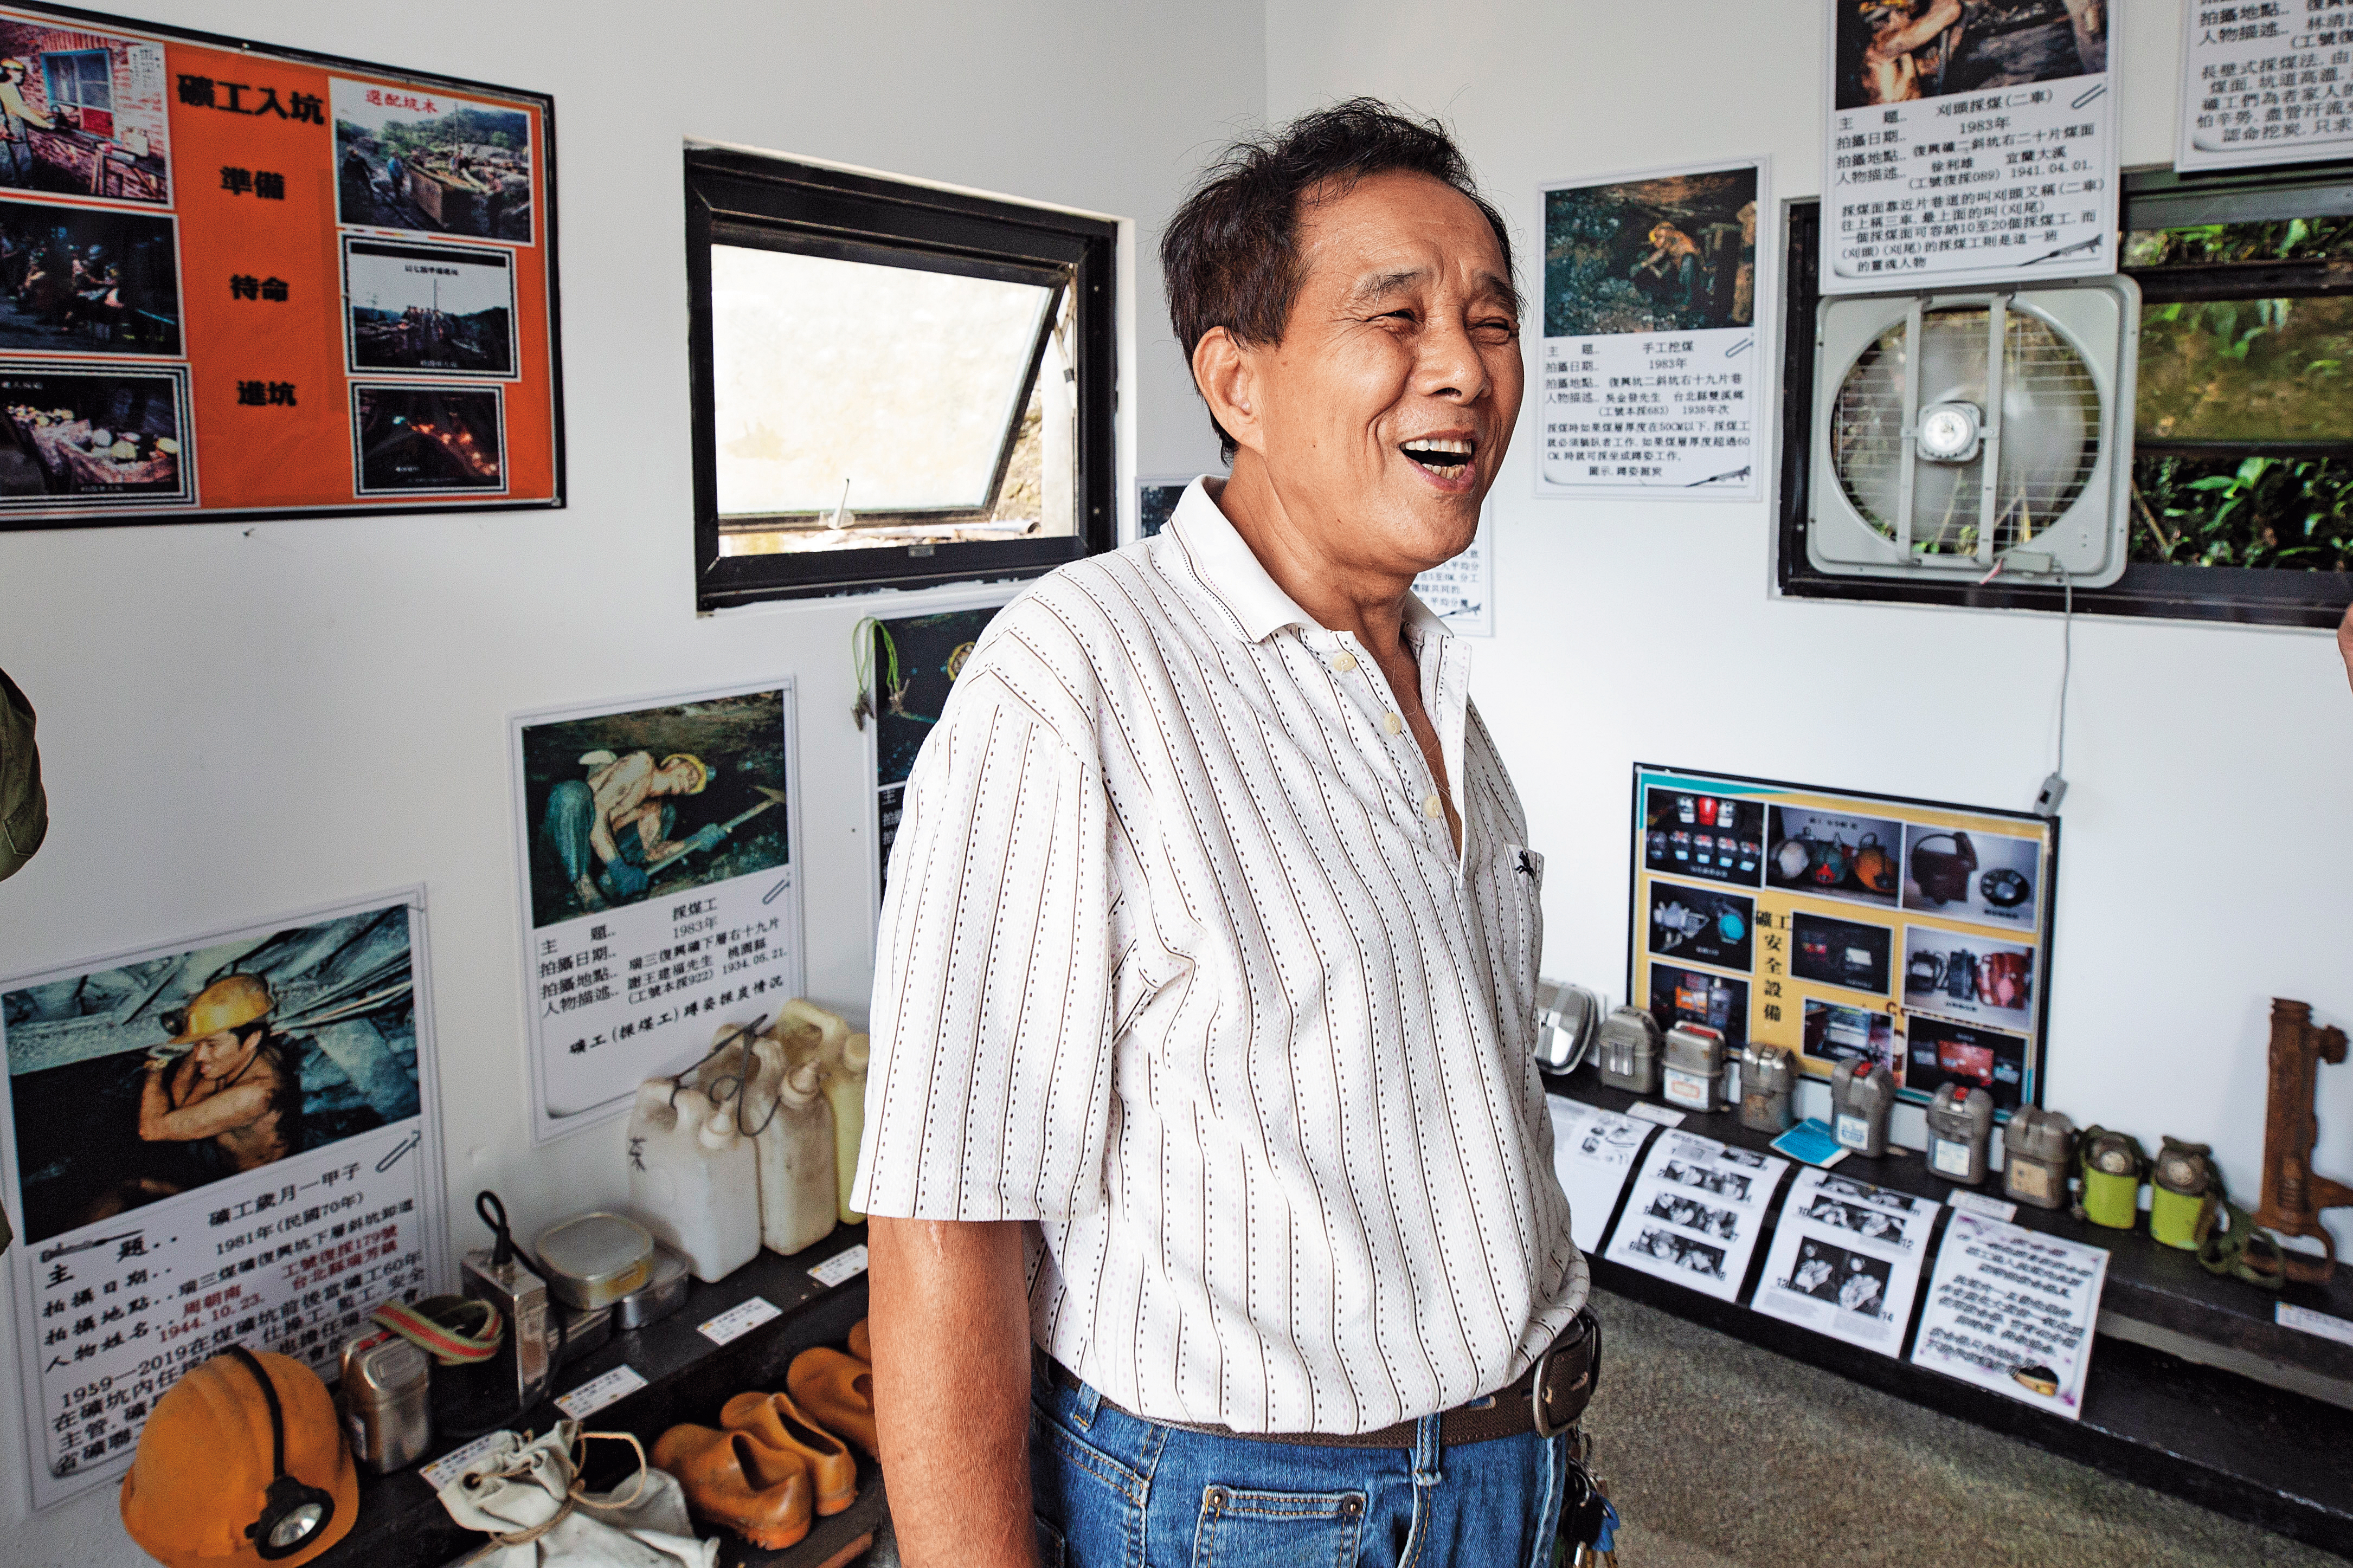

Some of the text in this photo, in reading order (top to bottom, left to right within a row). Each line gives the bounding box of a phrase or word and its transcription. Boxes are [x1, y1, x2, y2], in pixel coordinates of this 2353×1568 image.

[2307, 13, 2353, 30] 林清
[176, 74, 324, 126] 礦工入坑
[1840, 117, 1853, 131] 主
[1960, 117, 2009, 134] 1983年
[220, 167, 285, 201] 準備
[230, 275, 288, 302] 待命
[1644, 340, 1693, 353] 手工挖煤
[1650, 358, 1686, 370] 1983年
[237, 381, 296, 406] 進坑
[673, 896, 716, 921] 採煤工
[674, 917, 716, 939] 1983年
[45, 1264, 74, 1289] 主
